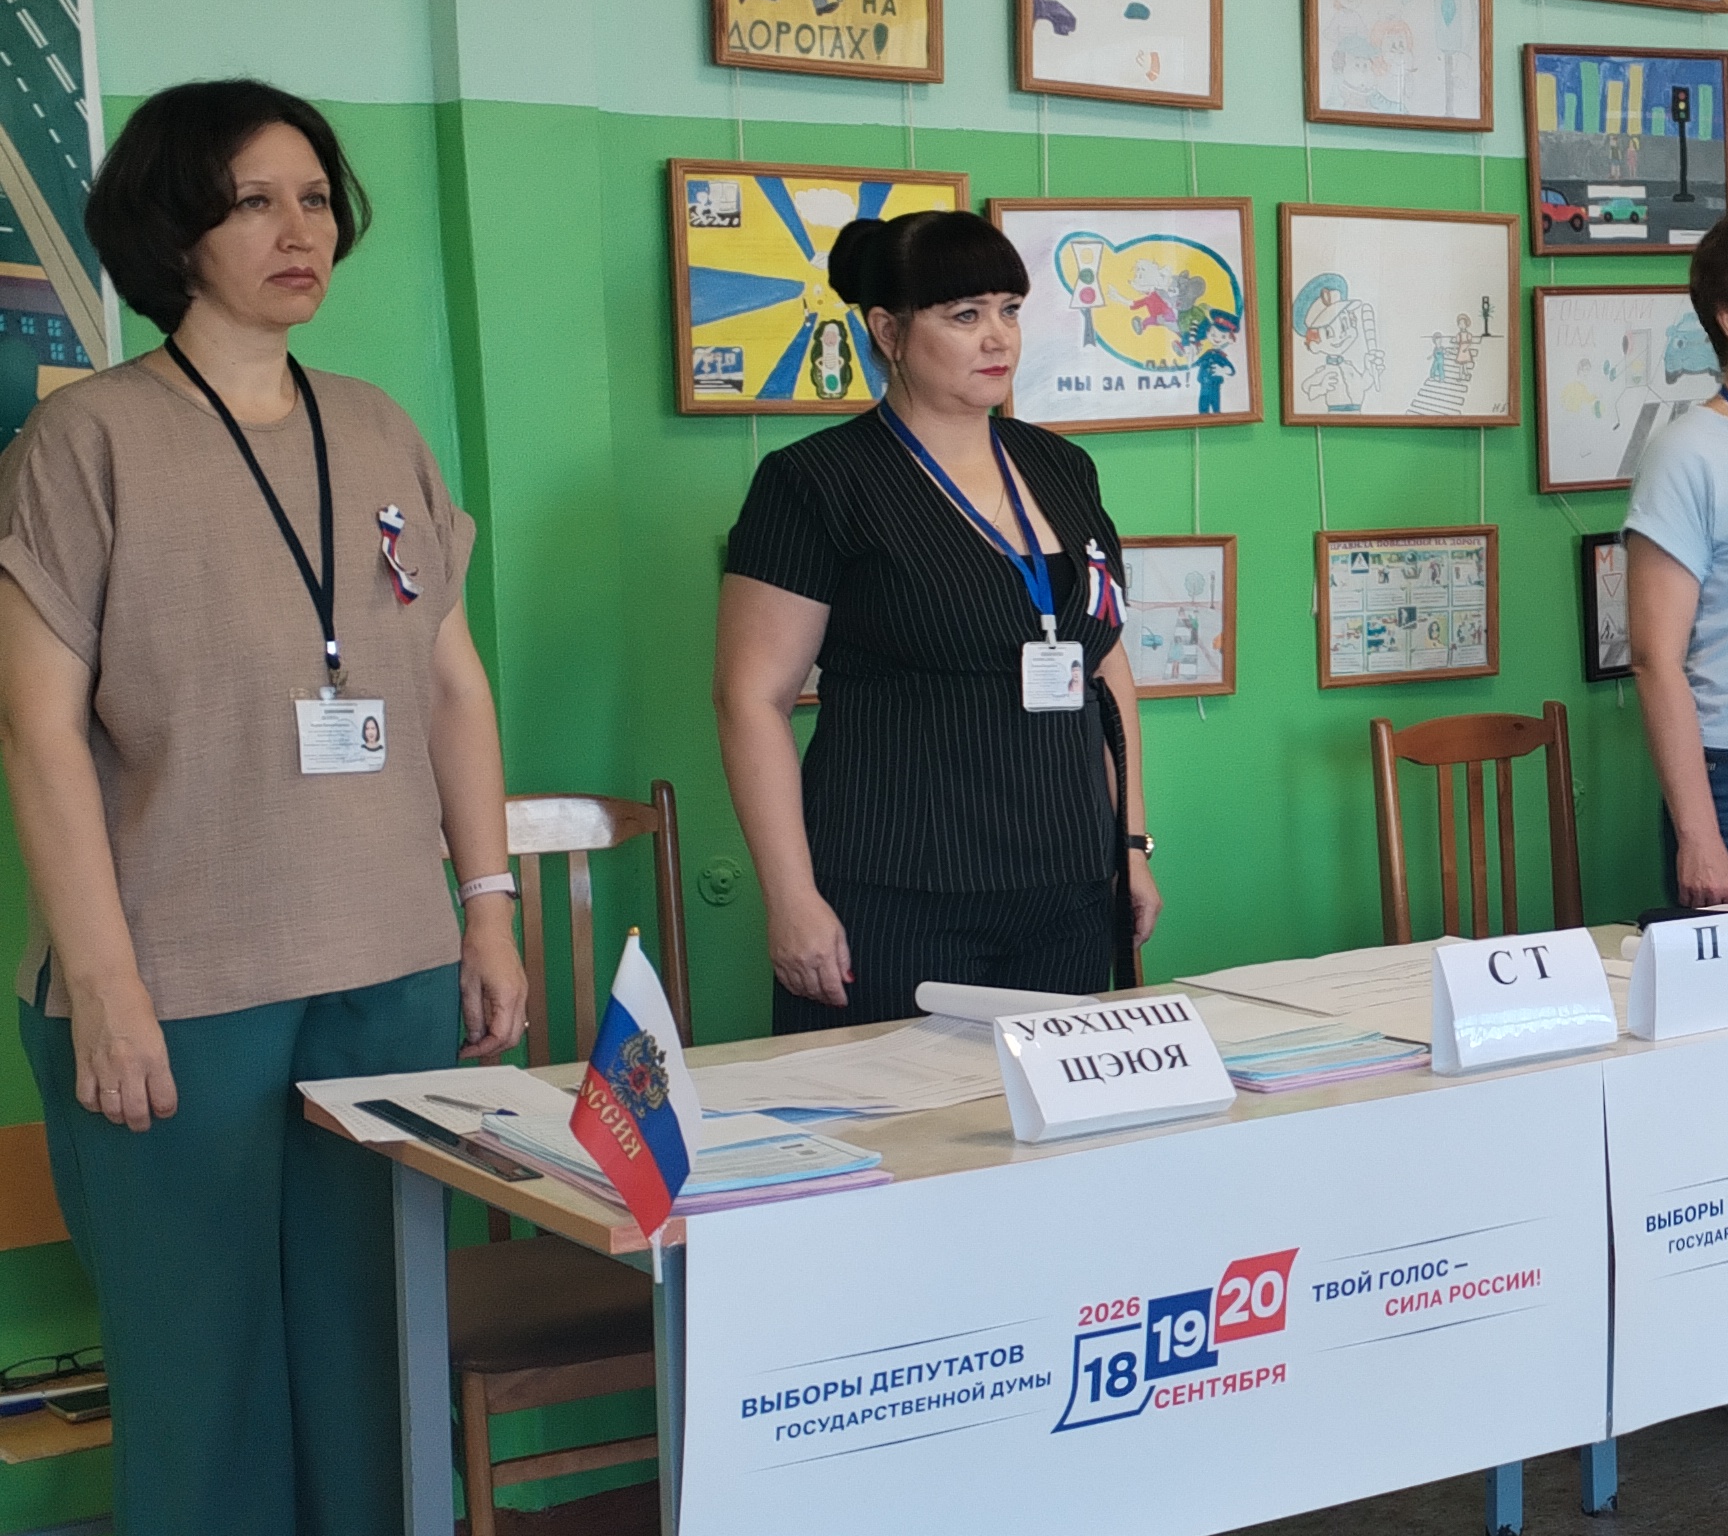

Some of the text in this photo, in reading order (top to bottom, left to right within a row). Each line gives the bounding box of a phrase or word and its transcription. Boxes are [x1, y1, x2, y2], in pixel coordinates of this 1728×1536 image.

[1057, 375, 1091, 392] МЫ
[1103, 376, 1125, 391] ЗА
[1012, 1001, 1192, 1041] УФХЦЧШ
[1057, 1043, 1192, 1084] ЩЭЮЯ
[581, 1080, 642, 1160] ССИЯ
[1647, 1199, 1723, 1232] ВЫБОРЫ
[1312, 1271, 1371, 1302] ТВОЙ
[1379, 1260, 1448, 1289] ГОЛОС
[1386, 1269, 1540, 1316] СИЛА РОССИИ!
[1078, 1297, 1140, 1326] 2026
[1084, 1272, 1283, 1402] 18 19 20
[742, 1345, 1024, 1418] ВЫБОРЫ ДЕПУТАТОВ
[1152, 1364, 1286, 1408] СЕНТЯБРЯ
[776, 1372, 1051, 1441] ГОСУДАРСТВЕННОЙ ДУМЫ
